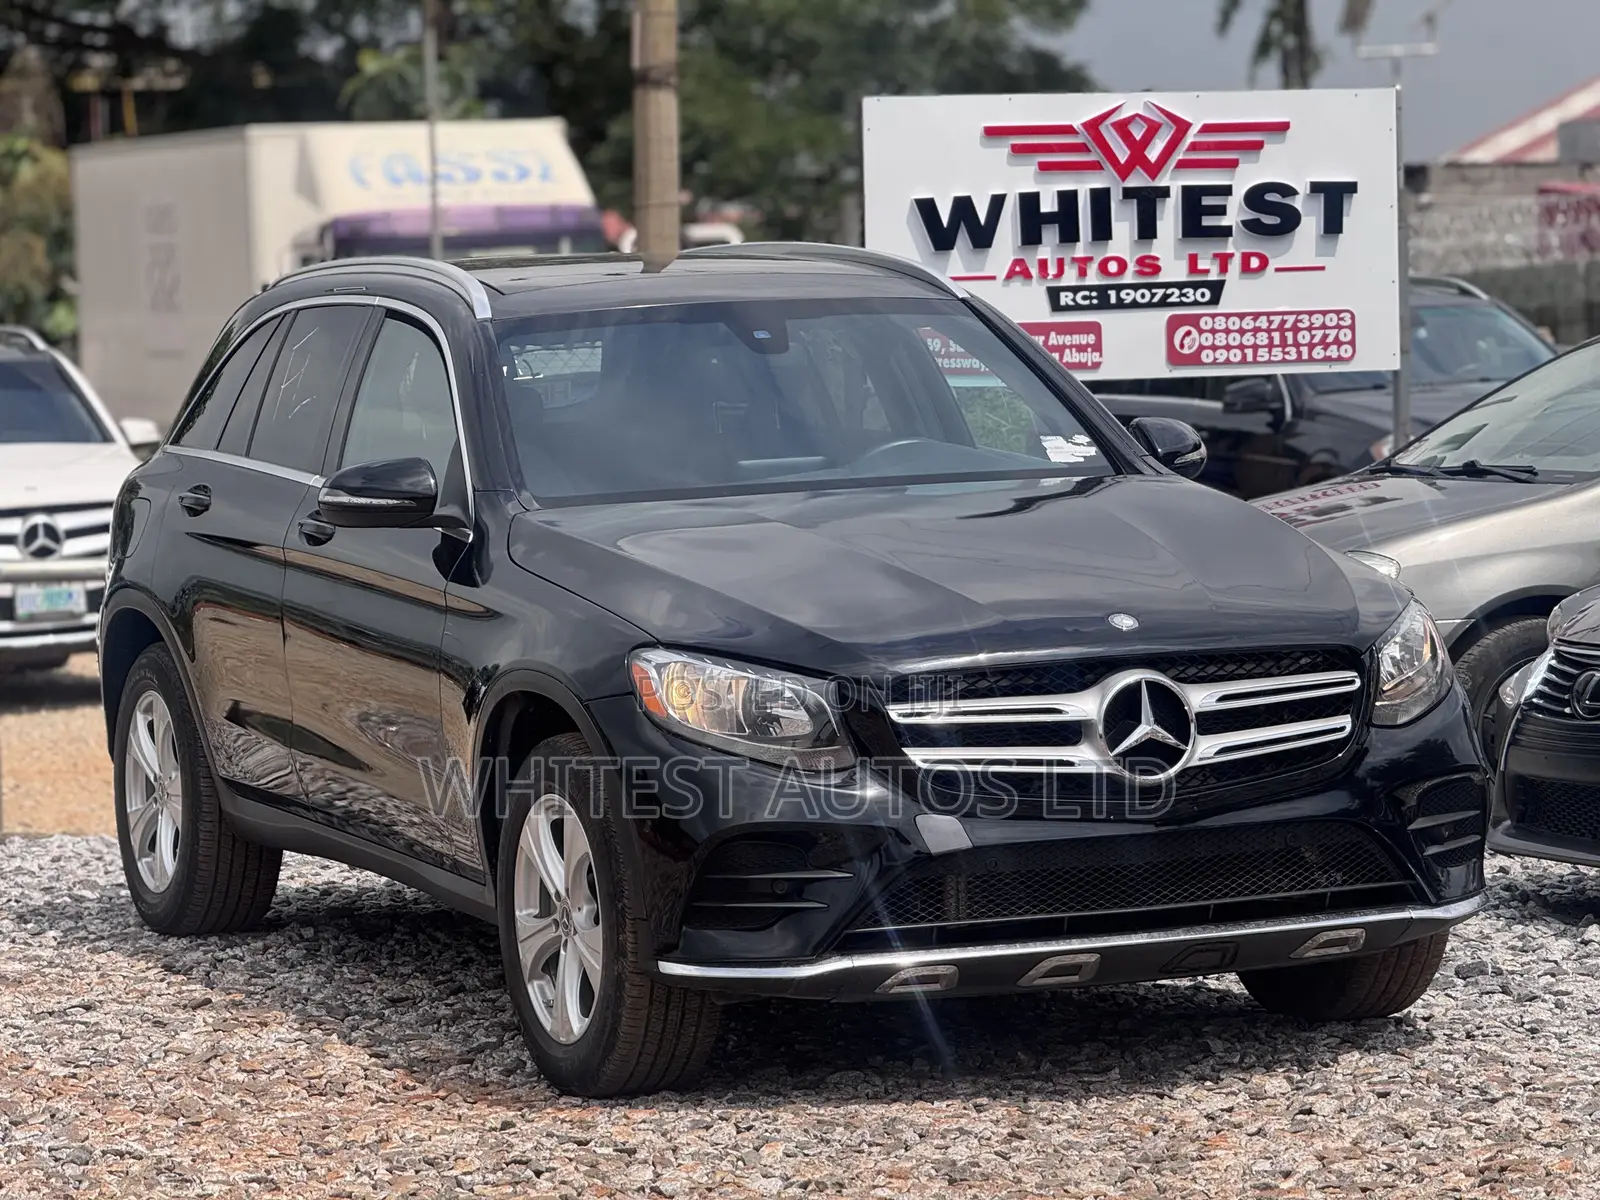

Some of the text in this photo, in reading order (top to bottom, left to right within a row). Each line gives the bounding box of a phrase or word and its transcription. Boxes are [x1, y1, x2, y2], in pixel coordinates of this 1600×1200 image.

[911, 181, 1358, 251] WHITEST
[1003, 252, 1269, 280] AUTOS LTD
[1059, 288, 1211, 306] RC: 1907230
[1199, 312, 1352, 330] 08064773903
[1048, 331, 1096, 346] Avenue
[1200, 328, 1352, 346] 08068110770
[1062, 347, 1103, 367] Abuja.
[1200, 344, 1353, 363] 09015531640
